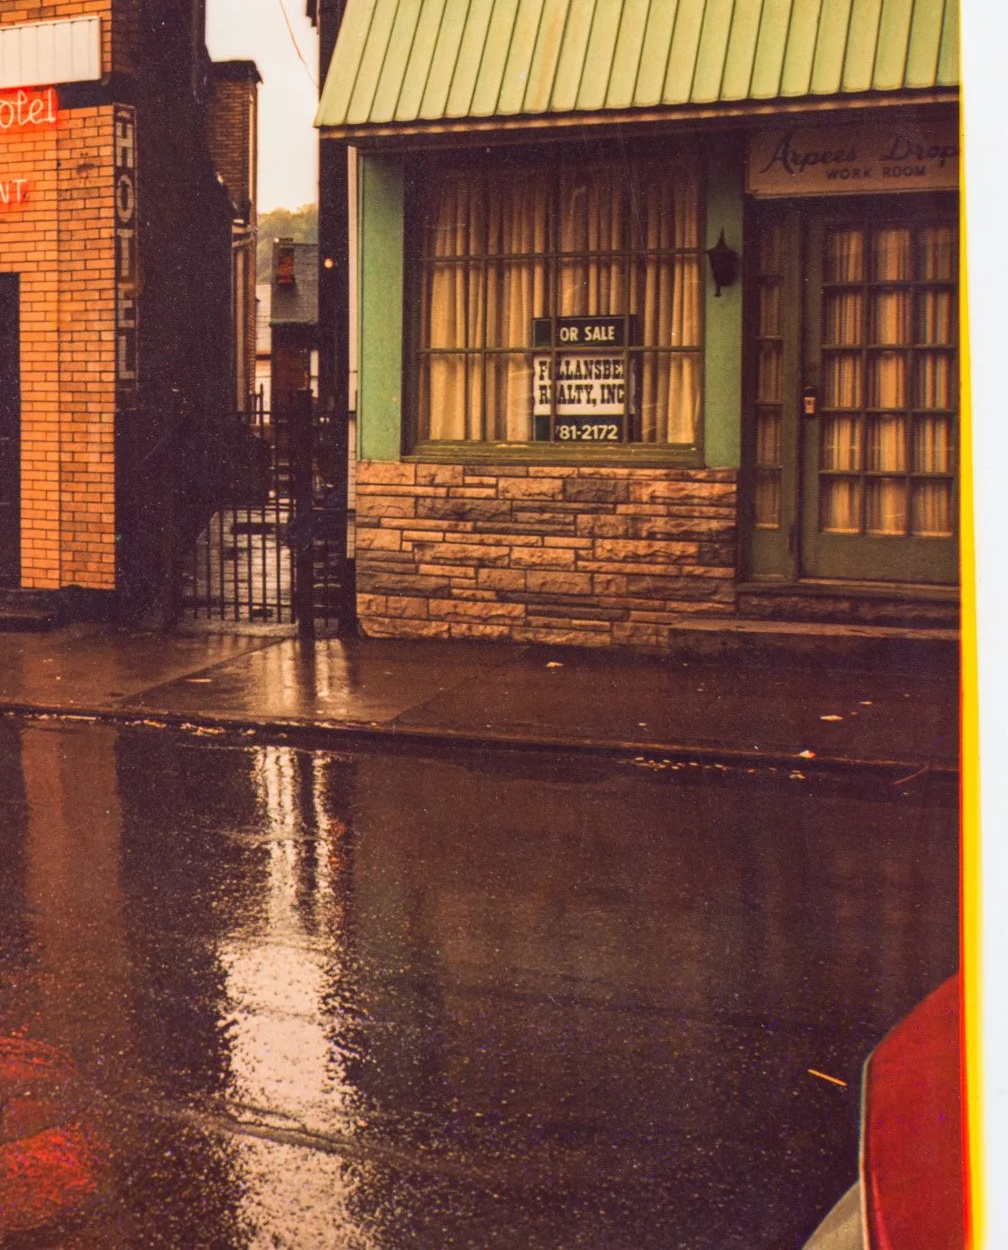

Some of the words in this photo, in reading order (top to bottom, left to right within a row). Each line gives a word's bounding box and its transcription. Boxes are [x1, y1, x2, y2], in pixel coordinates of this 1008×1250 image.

[826, 167, 873, 181] WORK
[882, 165, 927, 178] ROOM
[115, 122, 135, 380] HOTEL
[559, 326, 579, 342] OR
[584, 325, 616, 342] SALE
[538, 359, 625, 380] FLLANSBE
[538, 384, 597, 408] RALTY,
